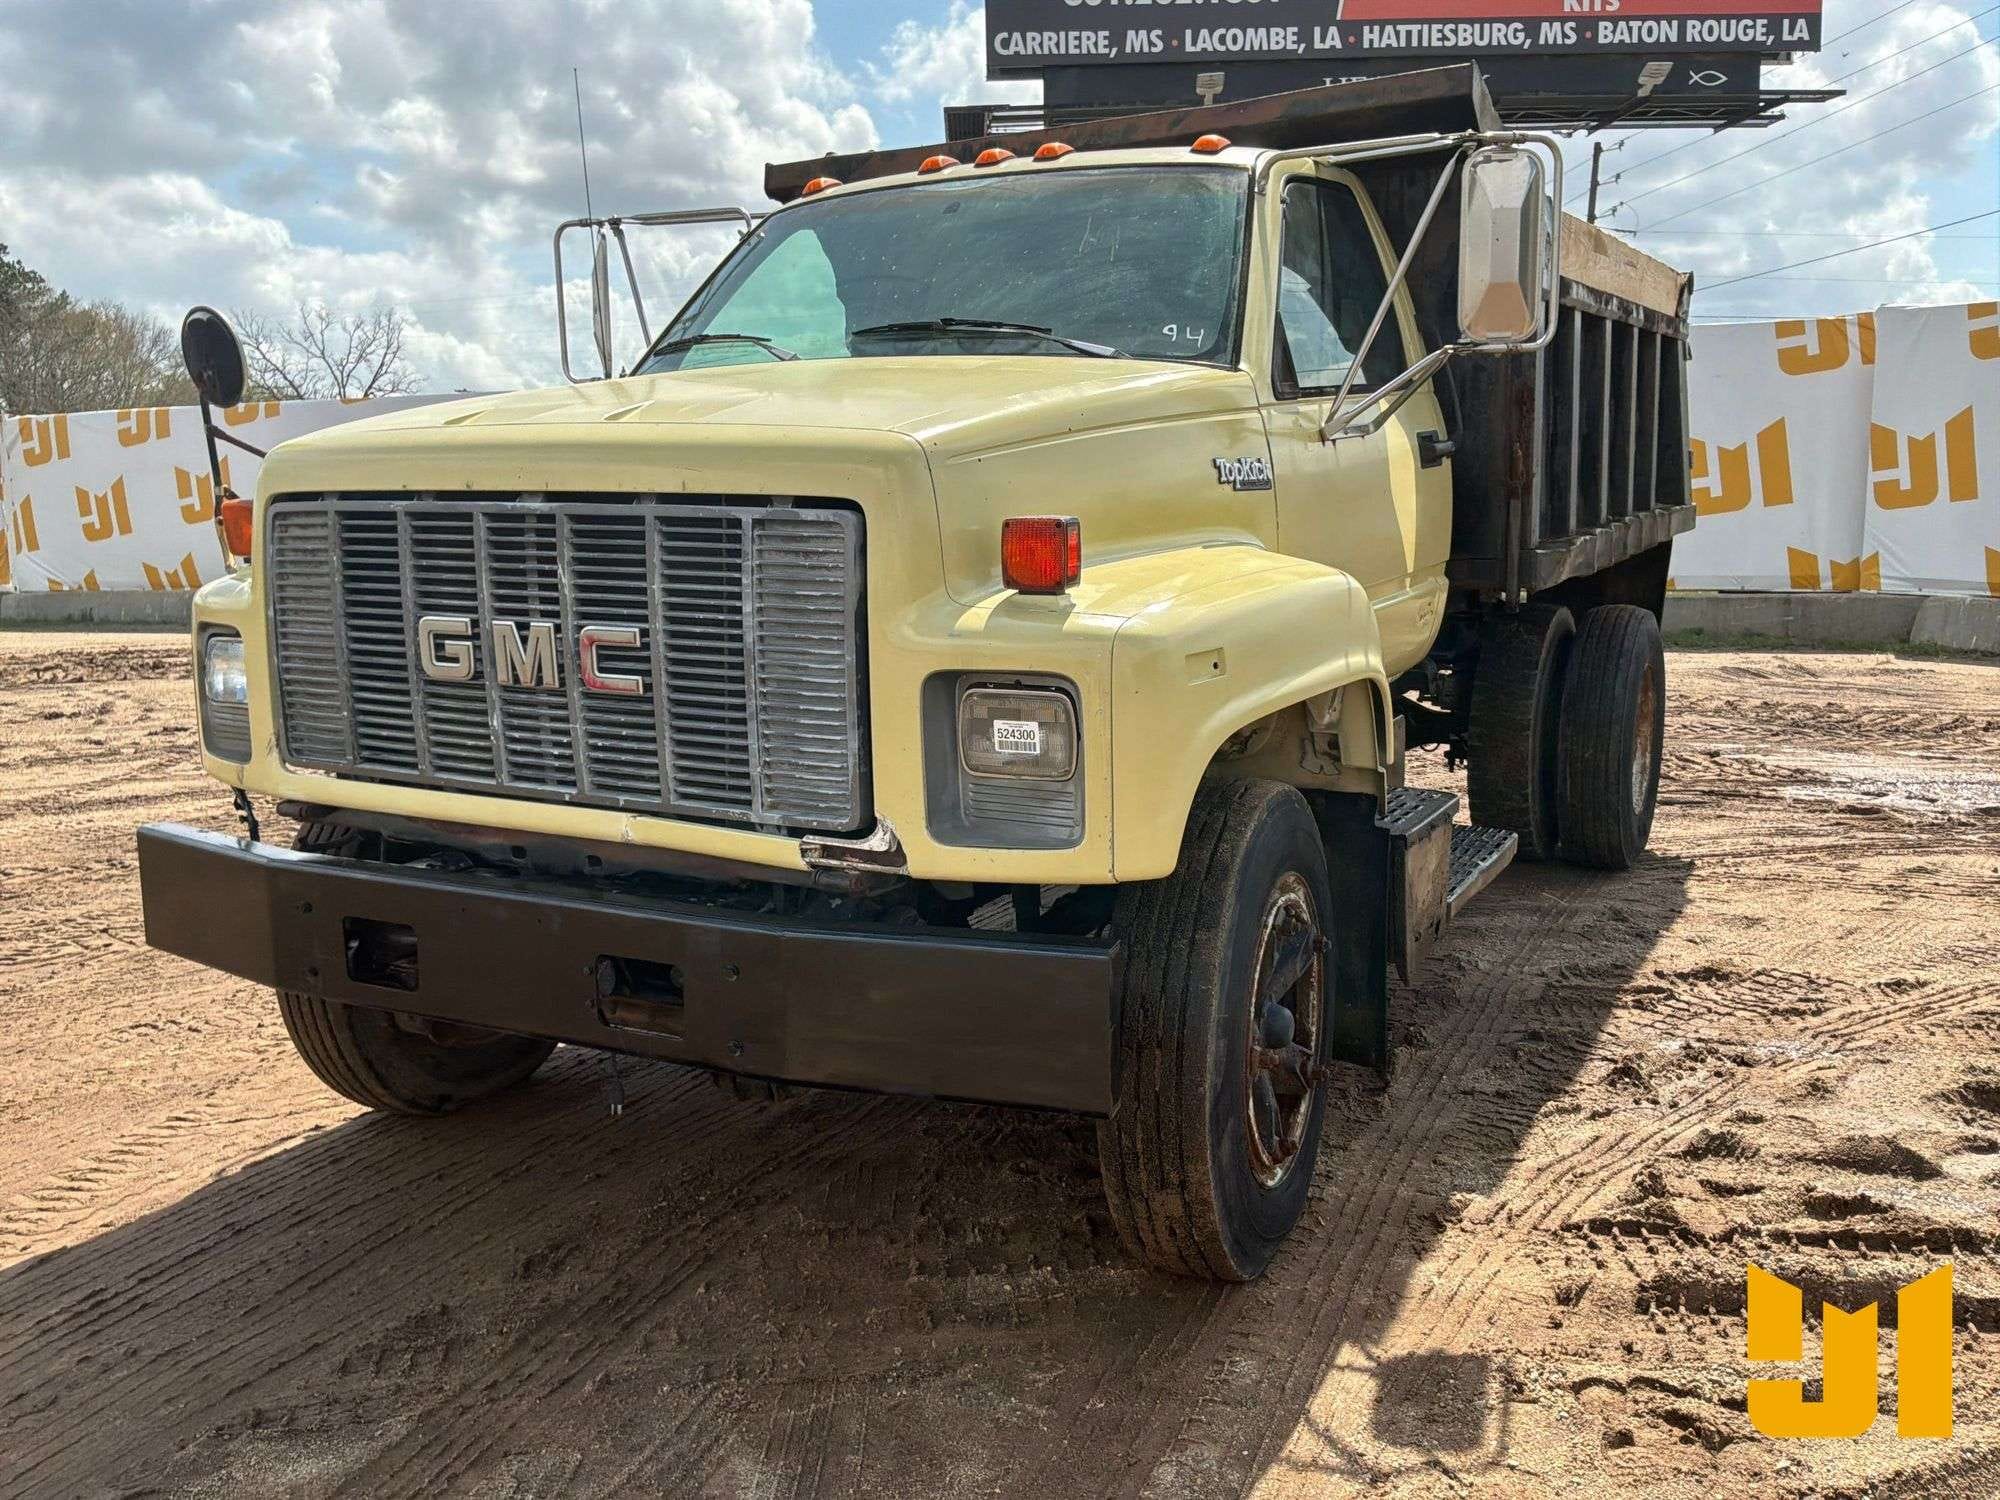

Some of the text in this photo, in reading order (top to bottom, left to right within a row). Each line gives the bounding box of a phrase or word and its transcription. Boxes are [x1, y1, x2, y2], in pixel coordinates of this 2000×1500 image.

[994, 18, 1810, 58] CARRIERE, MS LACOMBE, LA HATTIESBURG, MS BATON ROUGE, LA
[1162, 324, 1204, 348] 94
[418, 616, 643, 695] GMC
[997, 728, 1035, 740] 524300
